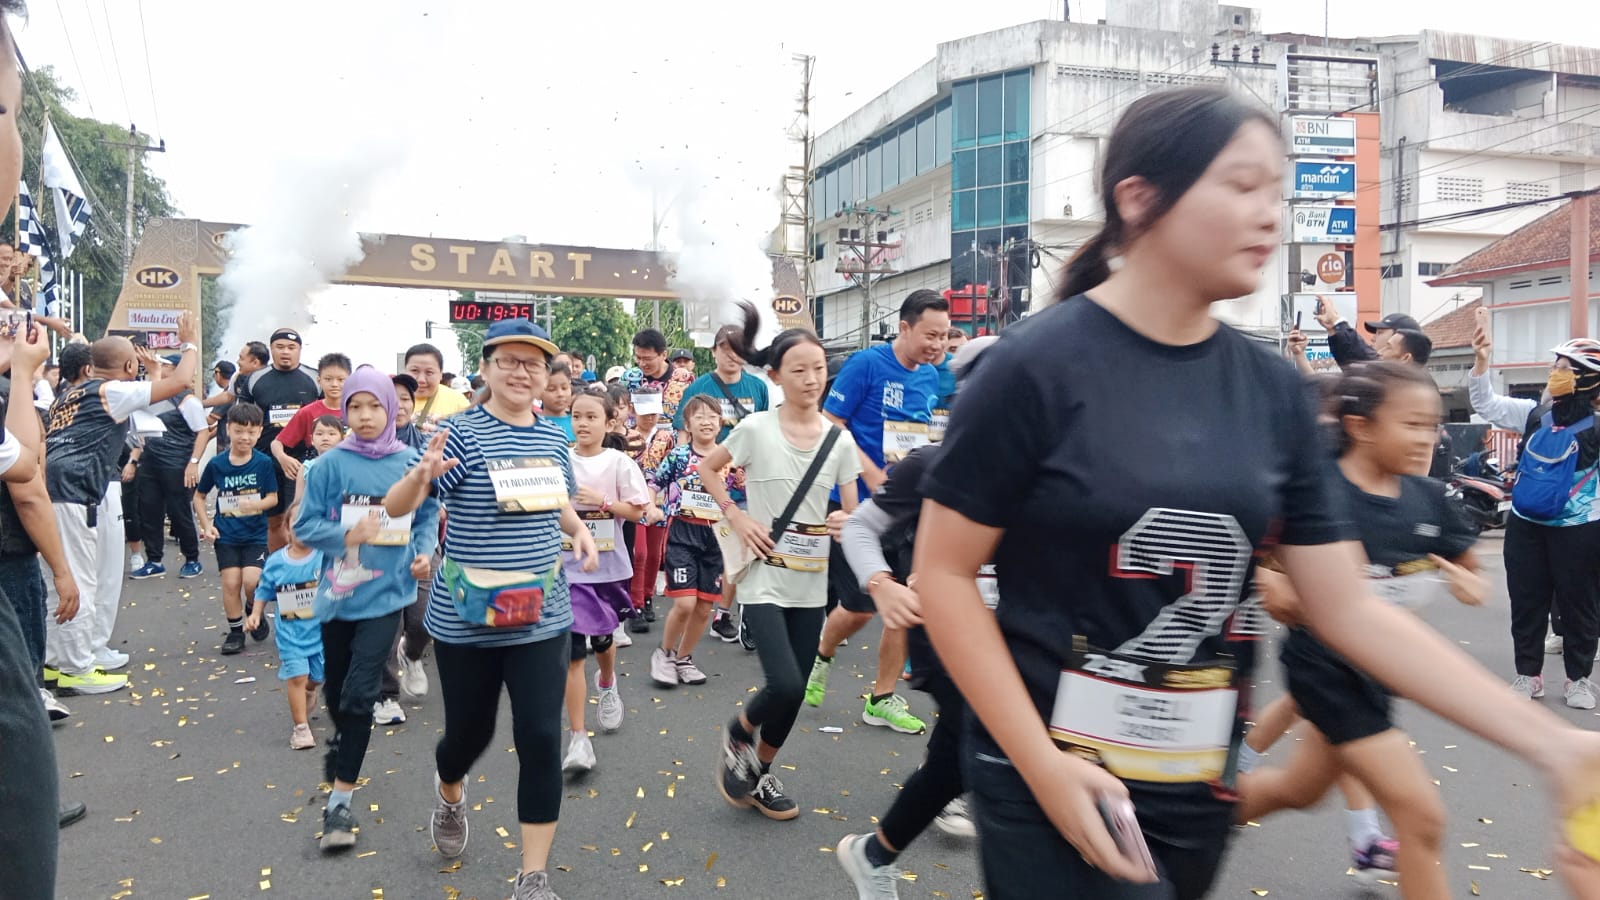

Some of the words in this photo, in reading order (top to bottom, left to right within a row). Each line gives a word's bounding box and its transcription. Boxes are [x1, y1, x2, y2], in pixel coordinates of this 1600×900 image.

[1307, 121, 1329, 135] BNI
[1296, 137, 1311, 145] ATM
[1300, 171, 1340, 185] mandiri
[1306, 219, 1326, 227] BTN
[1331, 220, 1349, 230] ATM
[409, 243, 592, 280] START
[1321, 254, 1343, 273] ria
[140, 271, 174, 285] HK
[775, 300, 798, 311] HK
[224, 474, 258, 489] NIKE
[498, 475, 560, 489] PENDAMPING
[673, 567, 688, 584] 16
